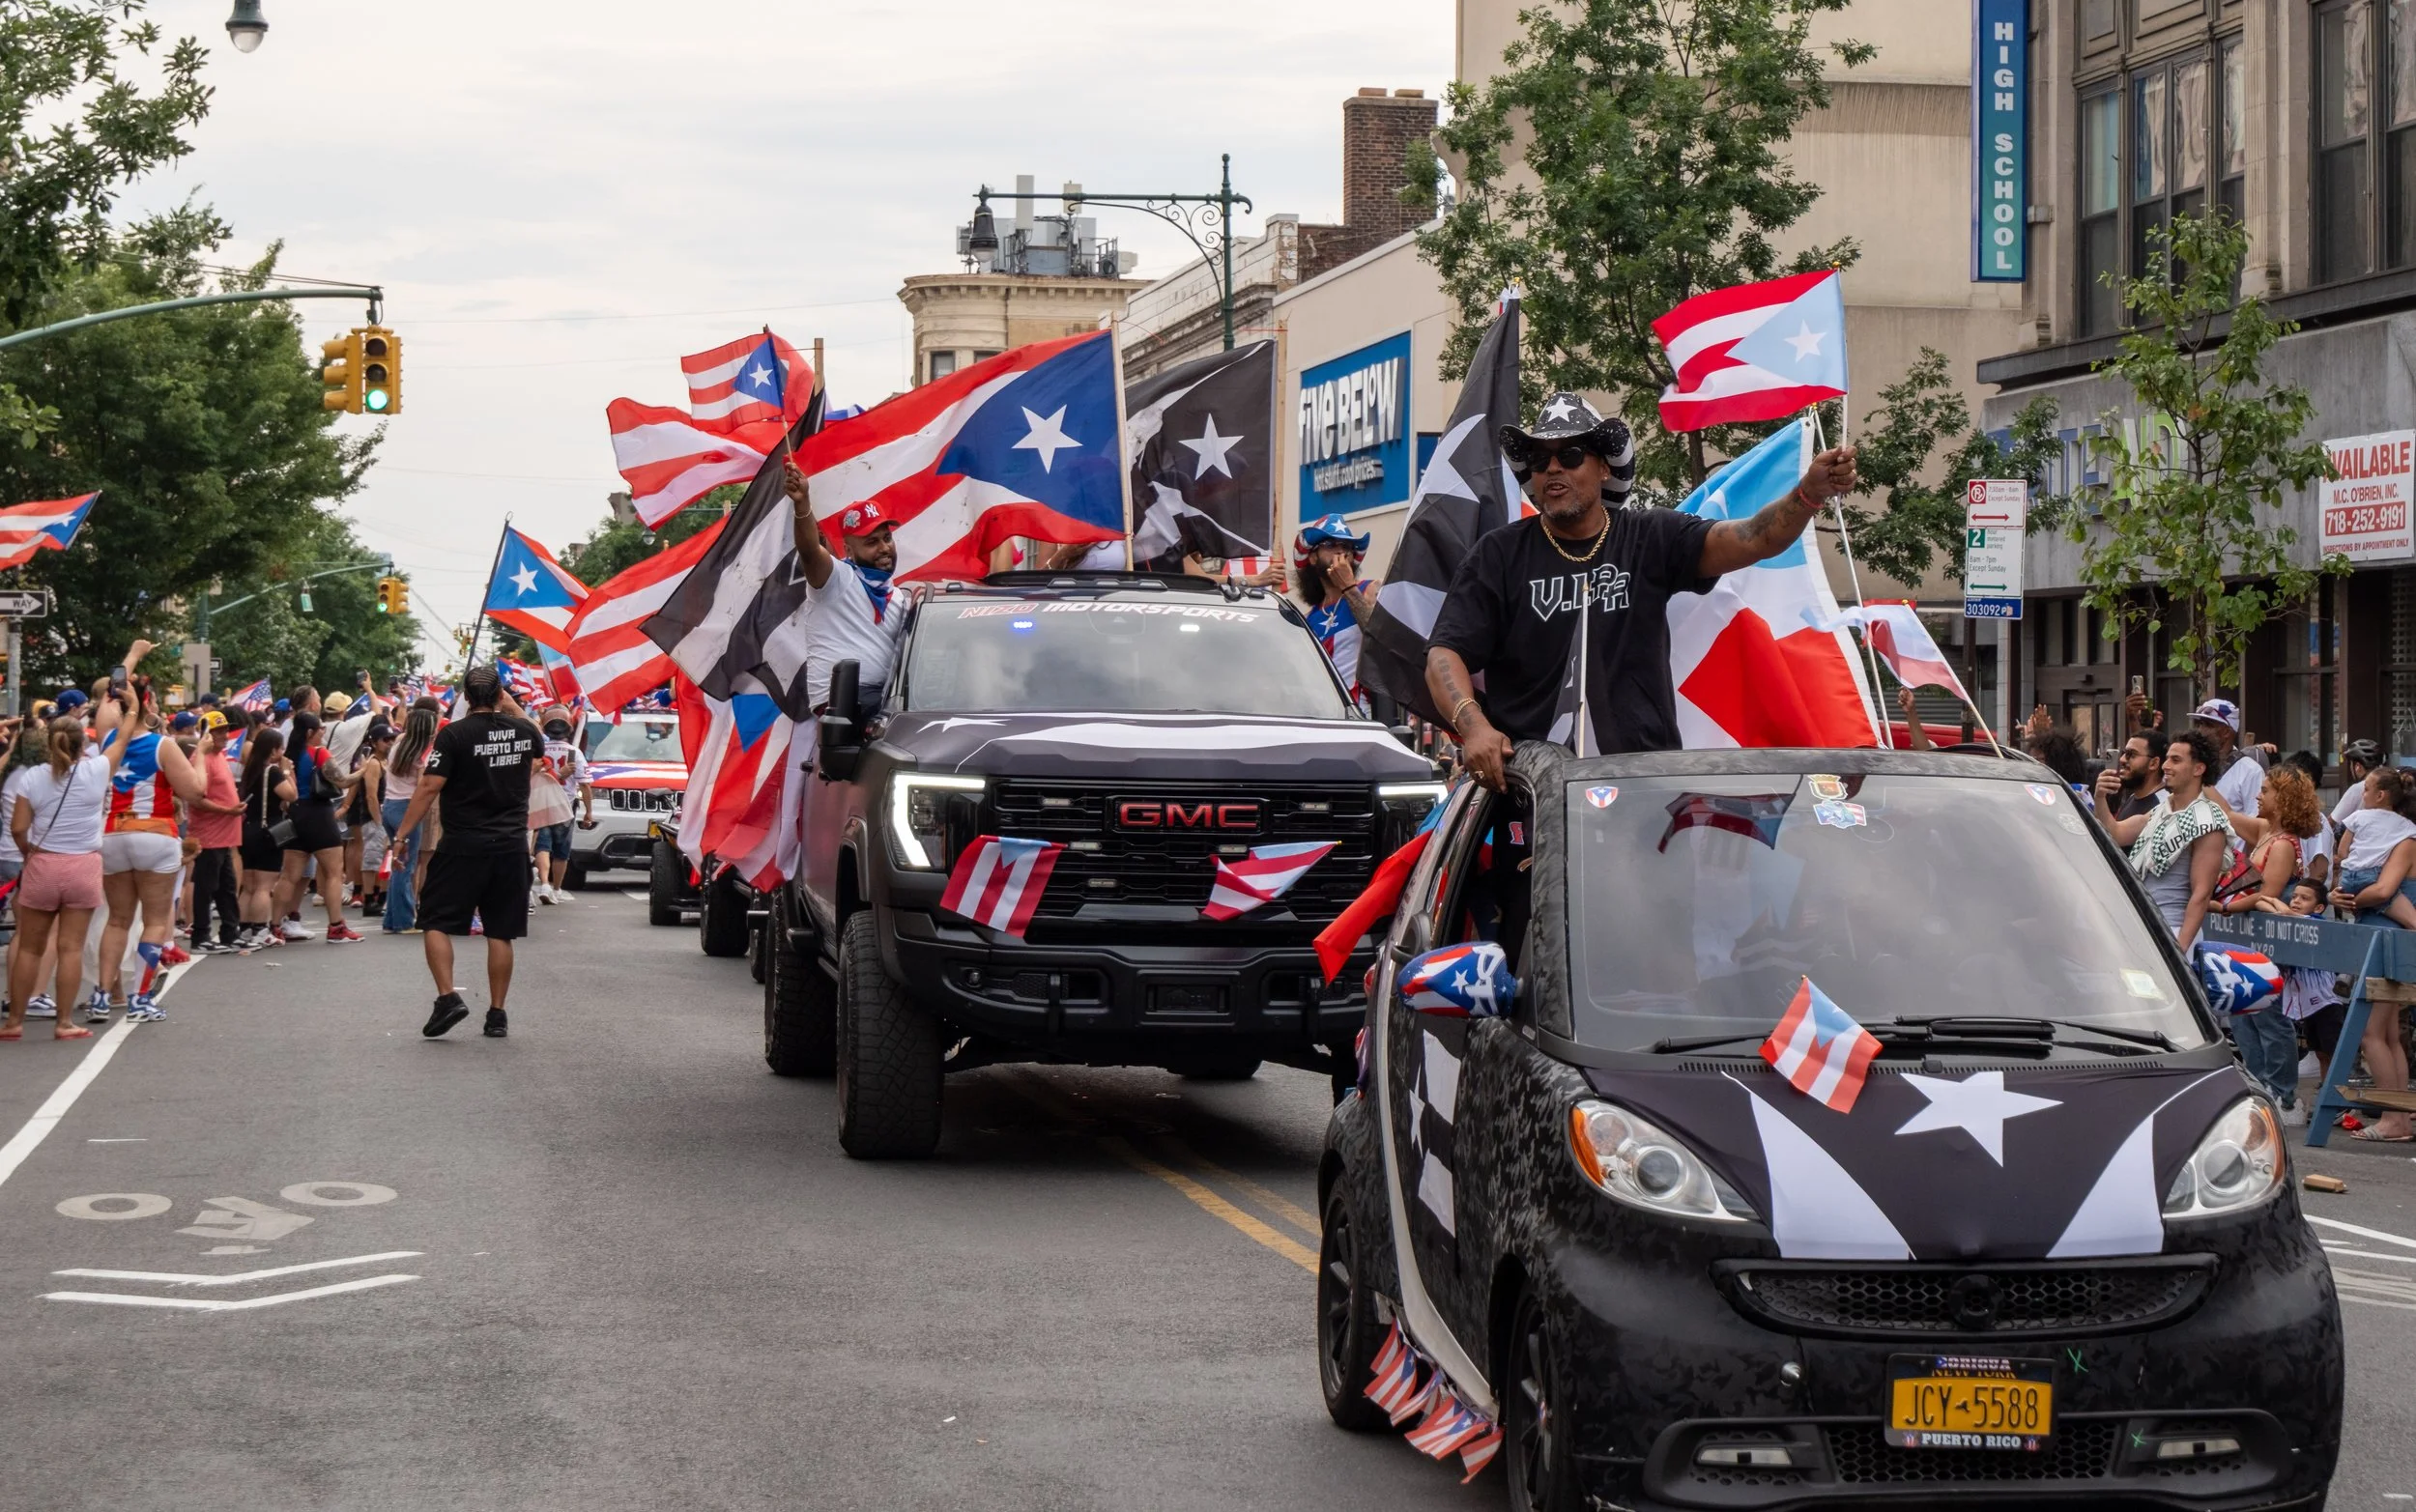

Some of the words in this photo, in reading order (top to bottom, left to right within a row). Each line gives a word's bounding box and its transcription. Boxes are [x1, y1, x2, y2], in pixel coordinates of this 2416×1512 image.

[1994, 22, 2015, 111] HIGH
[1994, 133, 2015, 270] SCHOOL
[2385, 483, 2400, 499] INC.
[2326, 504, 2404, 534] 718-252-9191
[1971, 528, 1981, 546] 2
[13, 600, 33, 609] WAY
[957, 602, 1040, 619] NIZO
[1043, 602, 1260, 624] MOTORSPORTS
[1967, 604, 2000, 616] 303092
[474, 742, 511, 756] PUERTO
[514, 739, 532, 753] RICO
[489, 754, 522, 767] LIBRE!
[1119, 803, 1258, 828] GMC
[2158, 823, 2226, 858] EUPHORIA
[2210, 913, 2234, 933] POLICE
[2239, 916, 2255, 936] LINE
[2265, 919, 2275, 939] DO
[2277, 921, 2292, 941] NOT
[2294, 924, 2319, 946] CROSS
[1904, 1383, 1953, 1427] JCY
[1972, 1385, 2039, 1430] 5588
[1921, 1433, 1982, 1447] PUERTO
[1986, 1435, 2022, 1448] RICO
